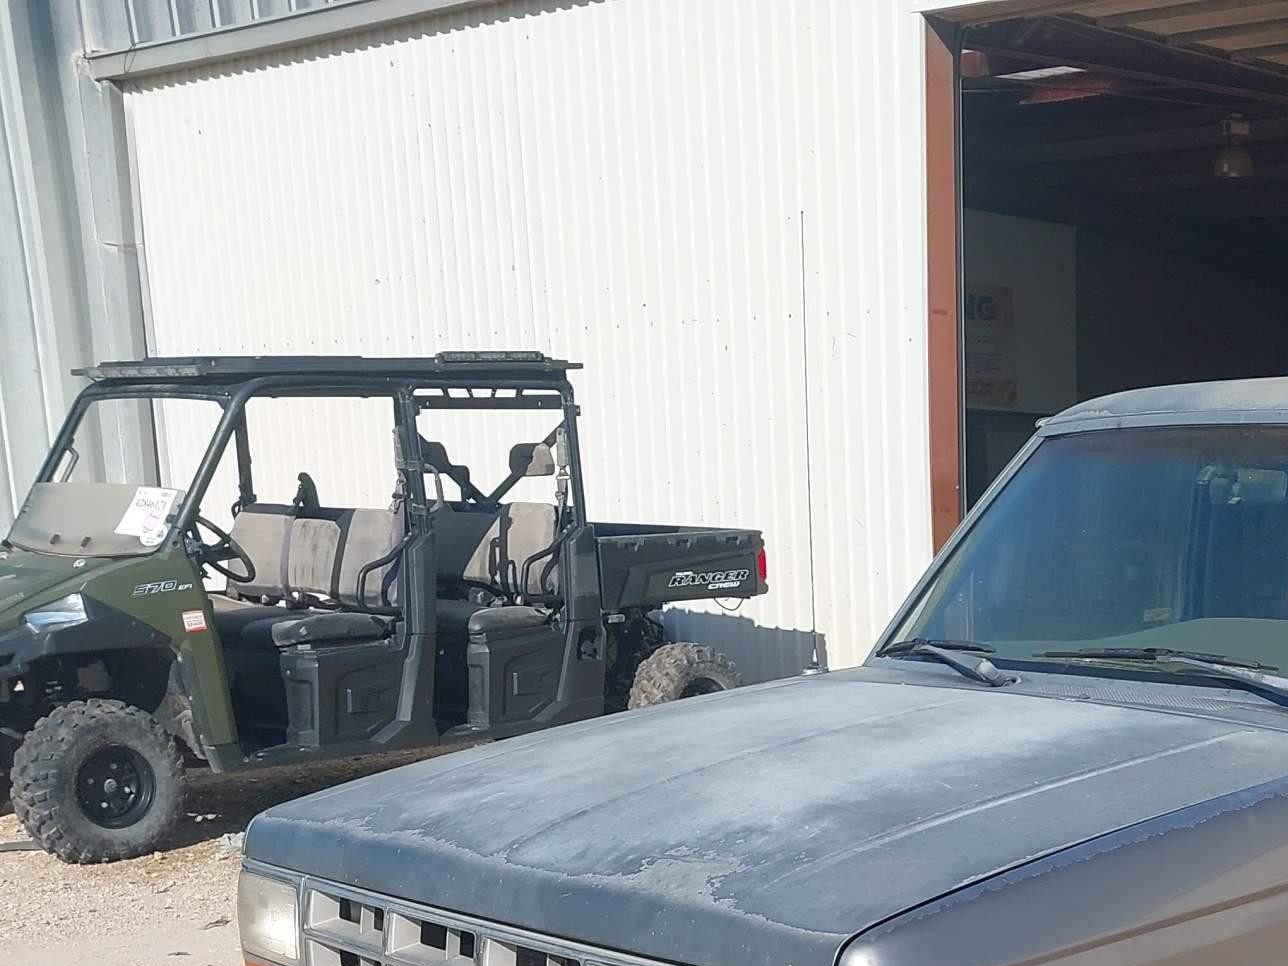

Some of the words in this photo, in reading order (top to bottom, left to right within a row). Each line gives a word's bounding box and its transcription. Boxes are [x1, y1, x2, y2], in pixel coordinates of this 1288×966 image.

[668, 569, 749, 587] RANGER
[707, 581, 740, 590] CREW
[133, 580, 178, 596] 570
